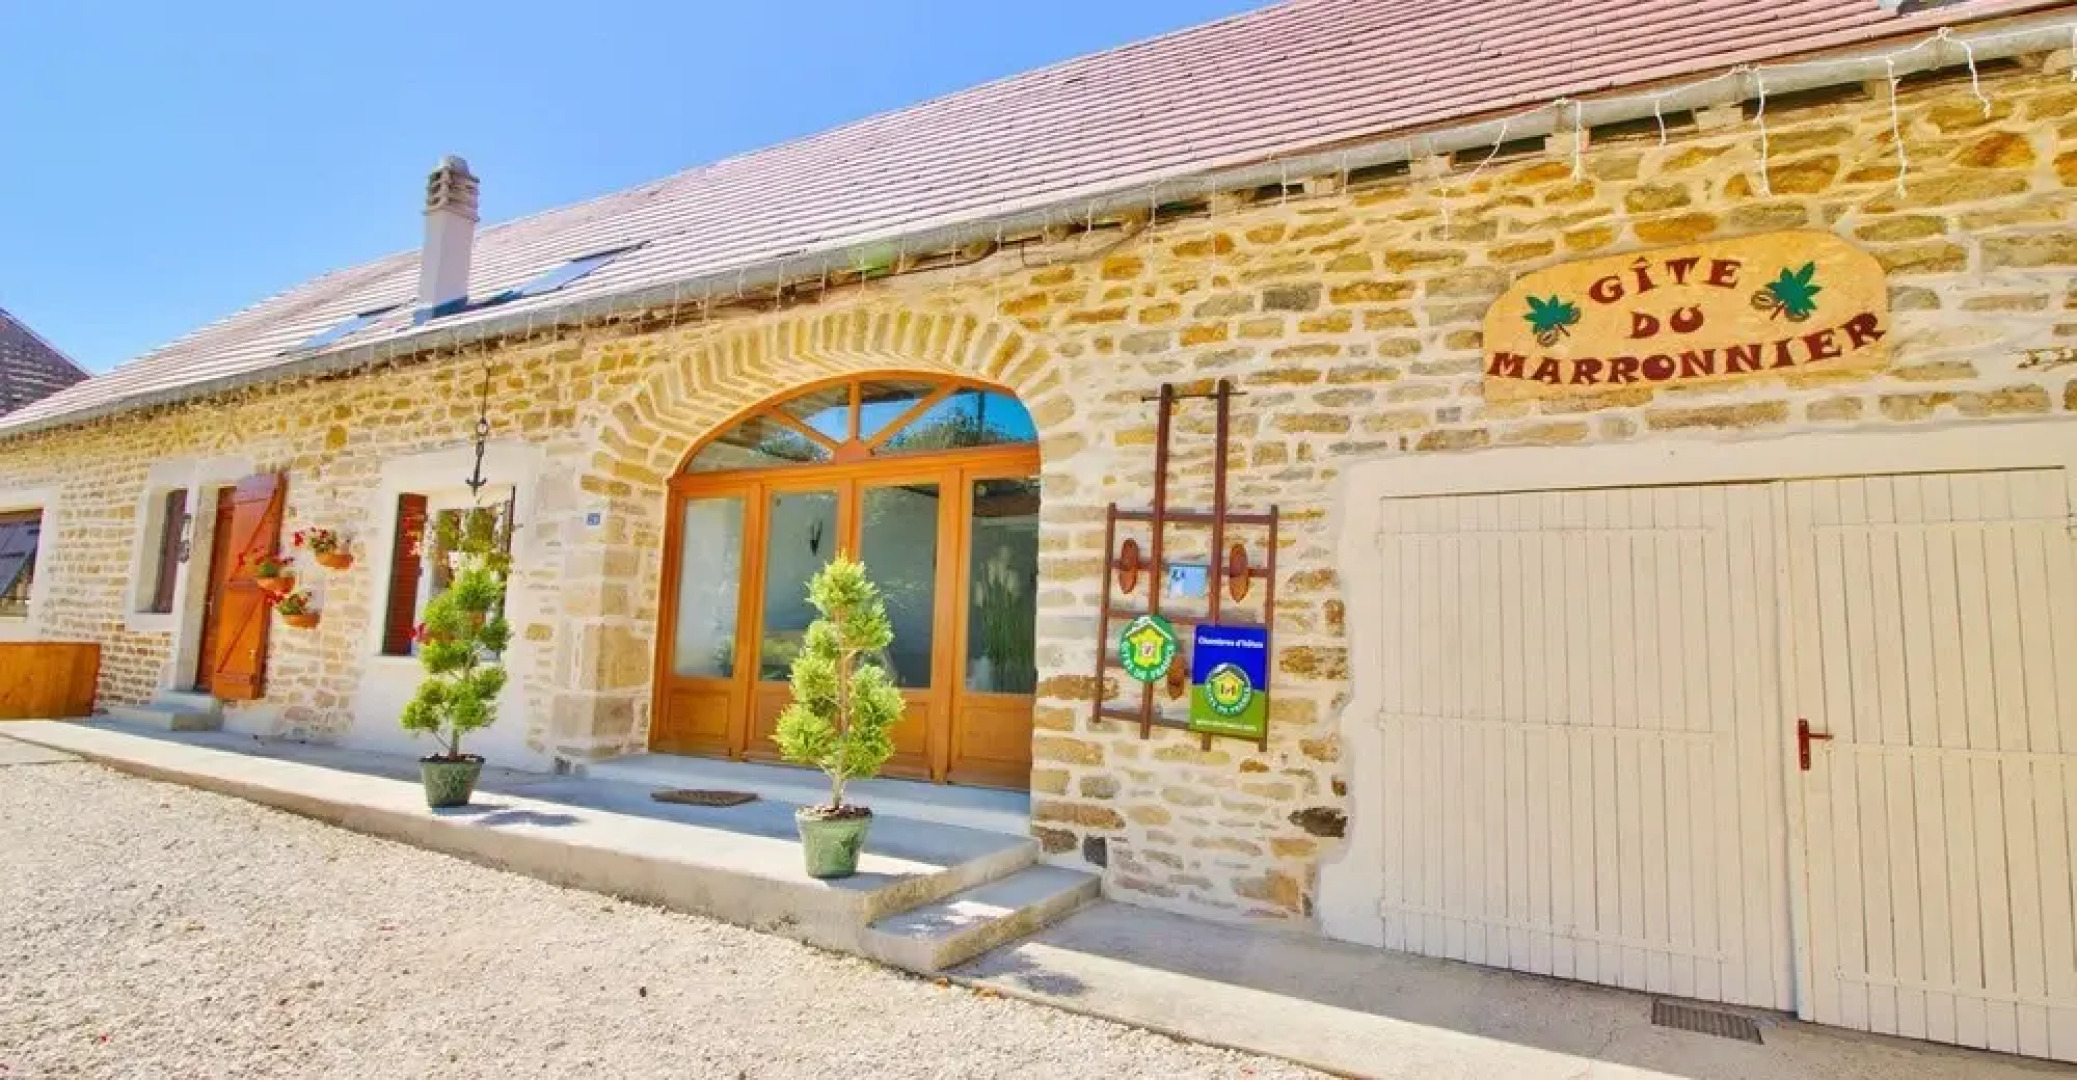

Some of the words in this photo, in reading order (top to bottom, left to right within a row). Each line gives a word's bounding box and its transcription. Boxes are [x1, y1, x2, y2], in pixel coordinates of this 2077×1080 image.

[1588, 256, 1742, 304] GÎTE
[1628, 303, 1705, 340] DU
[1487, 311, 1887, 386] MARRONNIER
